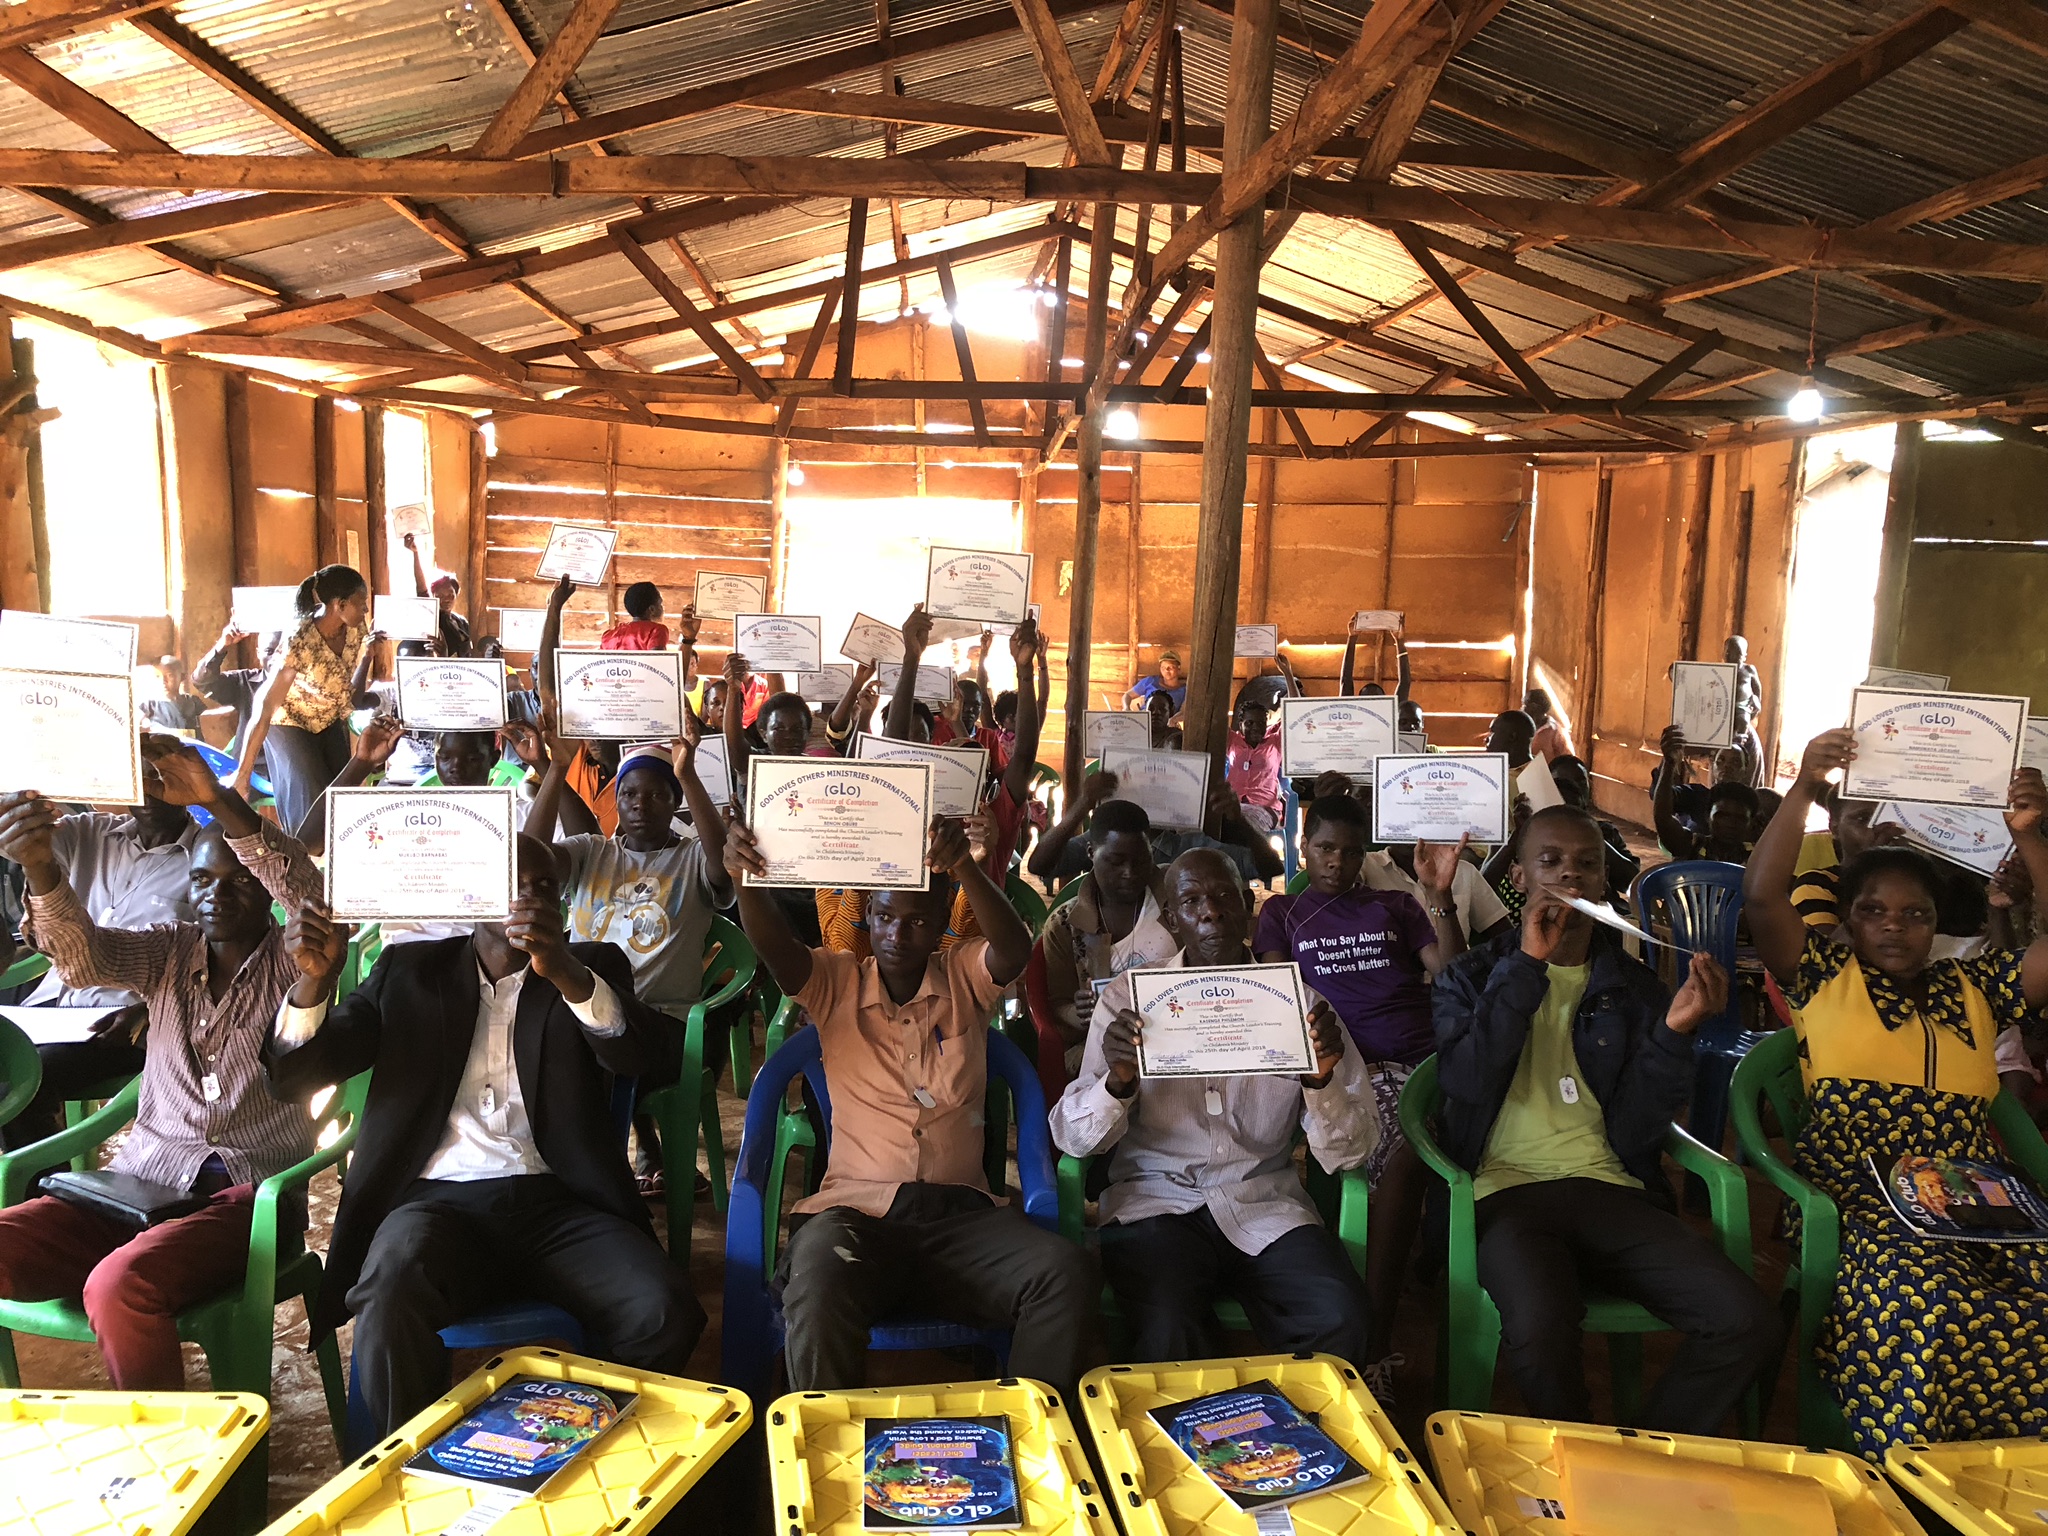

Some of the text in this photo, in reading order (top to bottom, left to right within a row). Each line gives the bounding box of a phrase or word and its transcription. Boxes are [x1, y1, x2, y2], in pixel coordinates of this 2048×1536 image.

[970, 562, 991, 572] (GLO)
[439, 672, 462, 681] (GLO)
[587, 659, 606, 669] OTHERS
[607, 658, 637, 666] MINISTRIES
[637, 661, 675, 687] INTERNATIONAL
[606, 667, 632, 678] (GLO)
[20, 692, 58, 708] (GLO)
[69, 685, 125, 727] INTERNATIONAL
[1328, 711, 1352, 721] (GLO)
[1858, 720, 1873, 733] GOD
[1872, 709, 1894, 722] LOVES
[1894, 701, 1922, 713] OTHERS
[1923, 701, 1965, 712] MINISTRIES
[1965, 707, 2013, 744] INTERNATIONAL
[1920, 712, 1955, 727] (GLO)
[911, 749, 942, 760] MINISTRIES
[943, 755, 977, 778] INTERNATIONAL
[1382, 779, 1393, 790] GOD
[1392, 770, 1408, 782] LOVES
[1408, 763, 1428, 772] OTHERS
[1461, 764, 1499, 790] INTERNATIONAL
[1427, 770, 1455, 781] (GLO)
[760, 770, 921, 814] GOD LOVES OTHERS MINISTRIES INTERNATIONAL
[825, 783, 861, 798] (GLO)
[807, 797, 836, 805] Certificate
[339, 799, 505, 842] GOD LOVES OTHERS MINISTRIES INTERNATIONAL
[404, 812, 442, 828] (GLO)
[1298, 938, 1318, 953] What
[1319, 936, 1337, 948] You
[1339, 935, 1356, 947] Say
[1359, 931, 1385, 943] About
[1318, 946, 1382, 962] Doesn't Matter
[1314, 958, 1390, 976] The Cross Matters
[1143, 1001, 1156, 1013] GOD
[1154, 988, 1174, 1002] LOVES
[1173, 978, 1199, 991] OTHERS
[1242, 978, 1294, 1006] INTERNATIONAL
[1201, 986, 1235, 999] (GLO)
[1896, 1175, 1937, 1226] GLO Club
[523, 1383, 599, 1403] GLO Club
[1235, 1396, 1263, 1406] Children
[1209, 1403, 1234, 1413] Around
[1239, 1403, 1265, 1412] Sharing
[1175, 1413, 1198, 1422] World
[1202, 1413, 1220, 1423] Love
[900, 1442, 972, 1450] Operations Guide
[448, 1446, 476, 1456] Sharing
[476, 1450, 497, 1460] God's
[497, 1455, 516, 1464] Love
[437, 1451, 467, 1461] Children
[466, 1458, 496, 1467] Around
[510, 1465, 533, 1476] World
[1255, 1464, 1335, 1491] GLO Club
[898, 1505, 993, 1518] GLO Club
